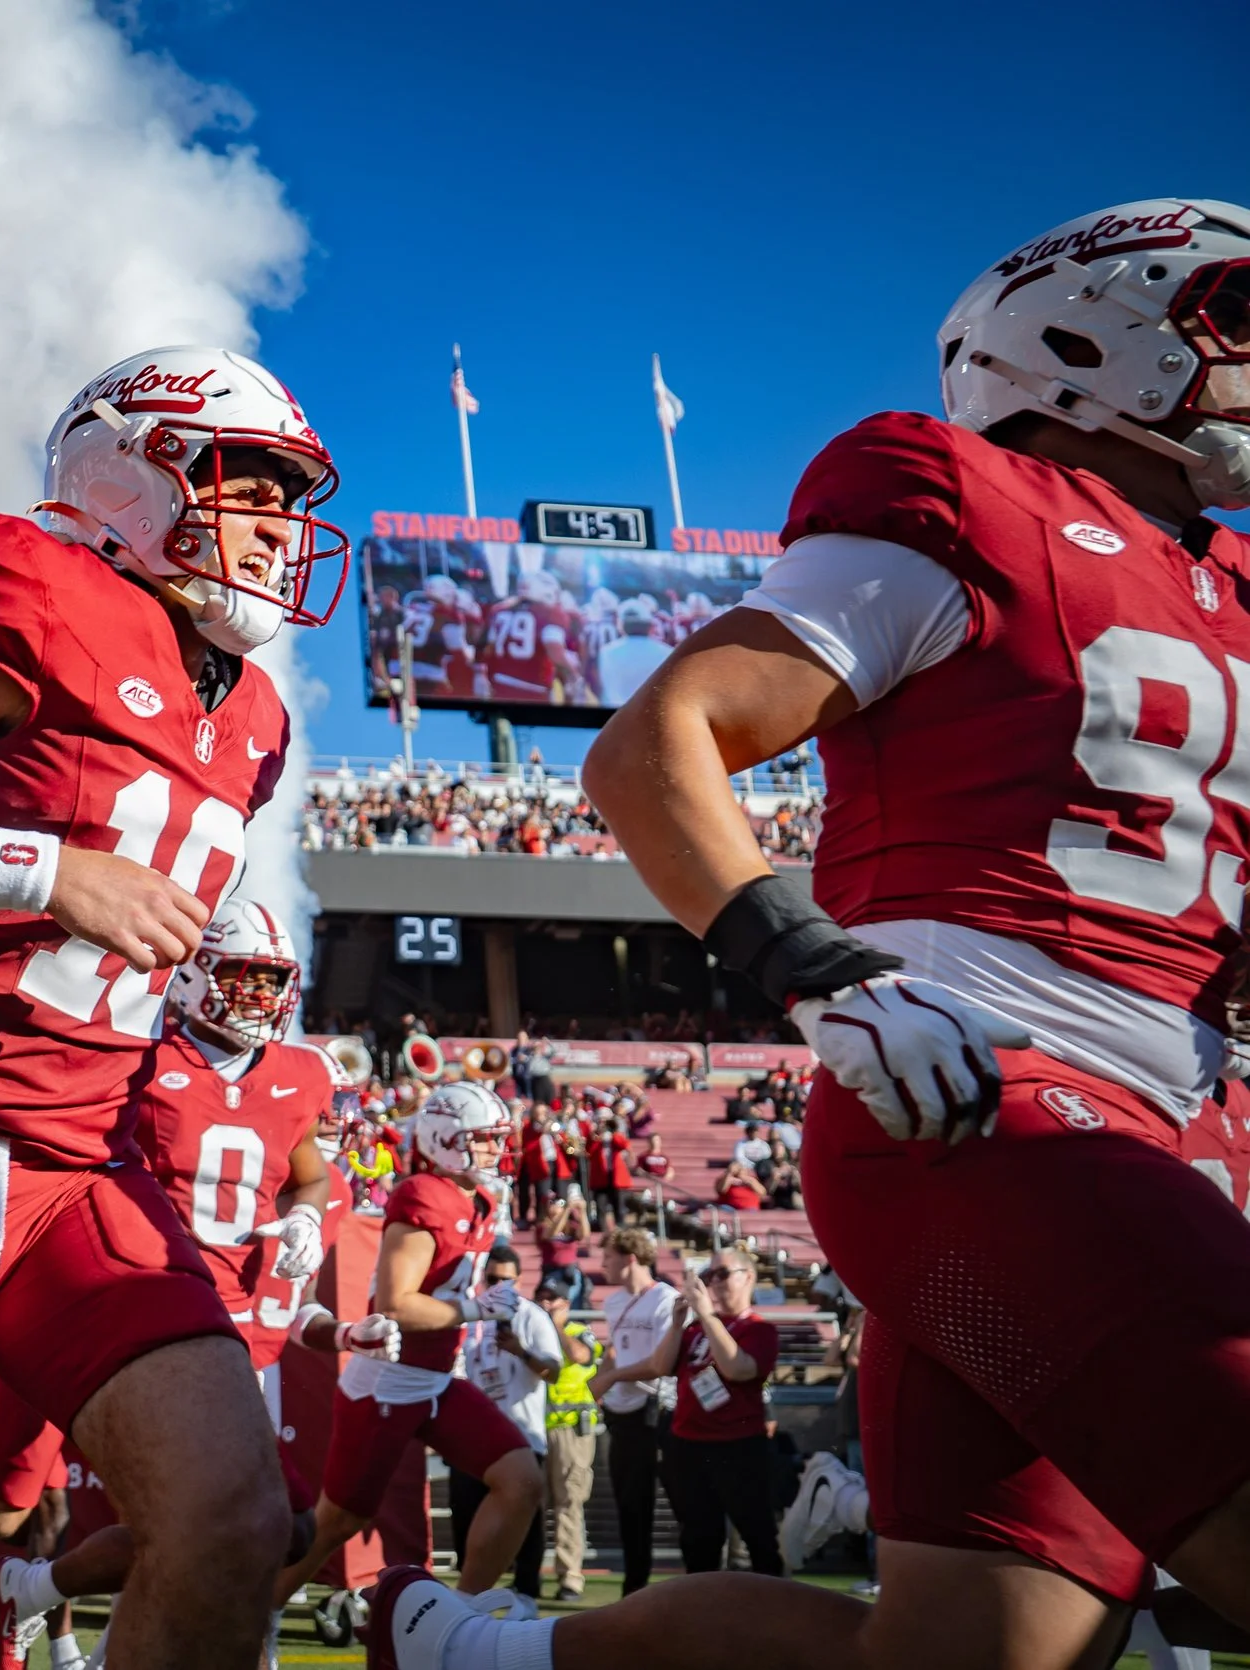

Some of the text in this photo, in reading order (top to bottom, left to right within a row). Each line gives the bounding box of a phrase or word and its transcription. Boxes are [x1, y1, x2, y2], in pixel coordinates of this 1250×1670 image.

[991, 205, 1192, 278] Stanford
[72, 364, 217, 411] Stanford
[372, 510, 521, 543] STANFORD
[567, 511, 638, 541] 4:57
[1073, 528, 1118, 547] ACC
[487, 610, 537, 660] 79
[124, 684, 158, 707] ACC
[398, 918, 459, 962] 25
[192, 1123, 265, 1248] 0
